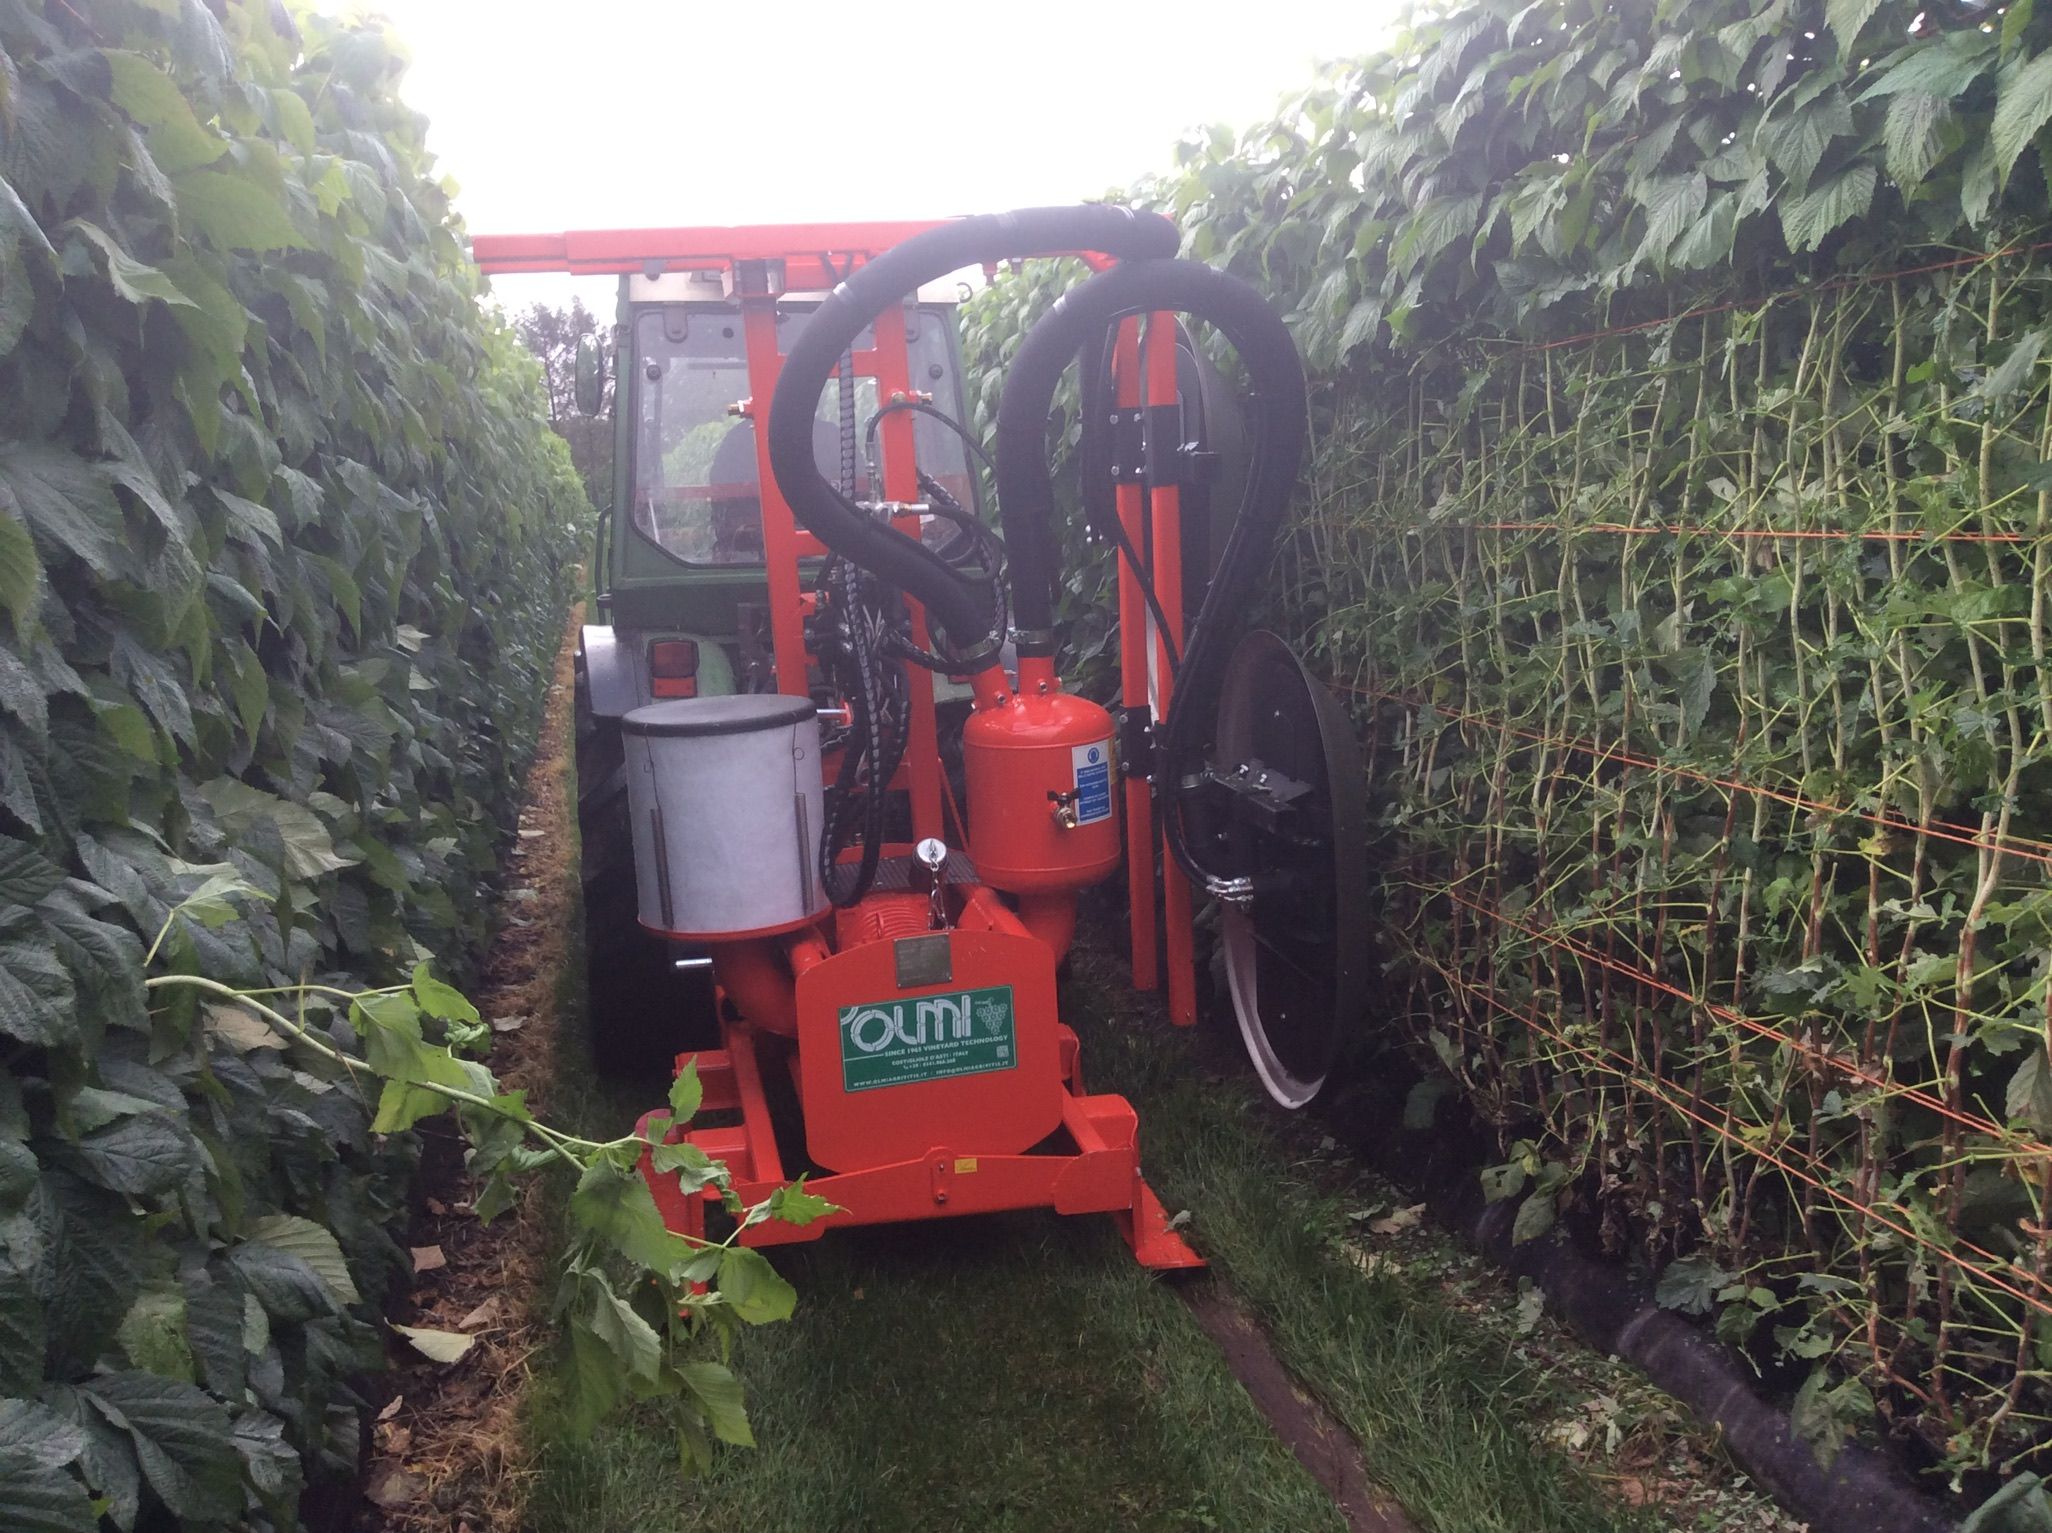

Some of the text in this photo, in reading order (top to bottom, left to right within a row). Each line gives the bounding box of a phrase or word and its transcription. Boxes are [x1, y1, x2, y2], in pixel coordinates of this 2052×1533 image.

[850, 995, 971, 1052] OLMI
[885, 1048, 905, 1057] SINCE
[924, 1041, 960, 1052] VINEYARD
[961, 1035, 1008, 1047] TECHNOLOGY
